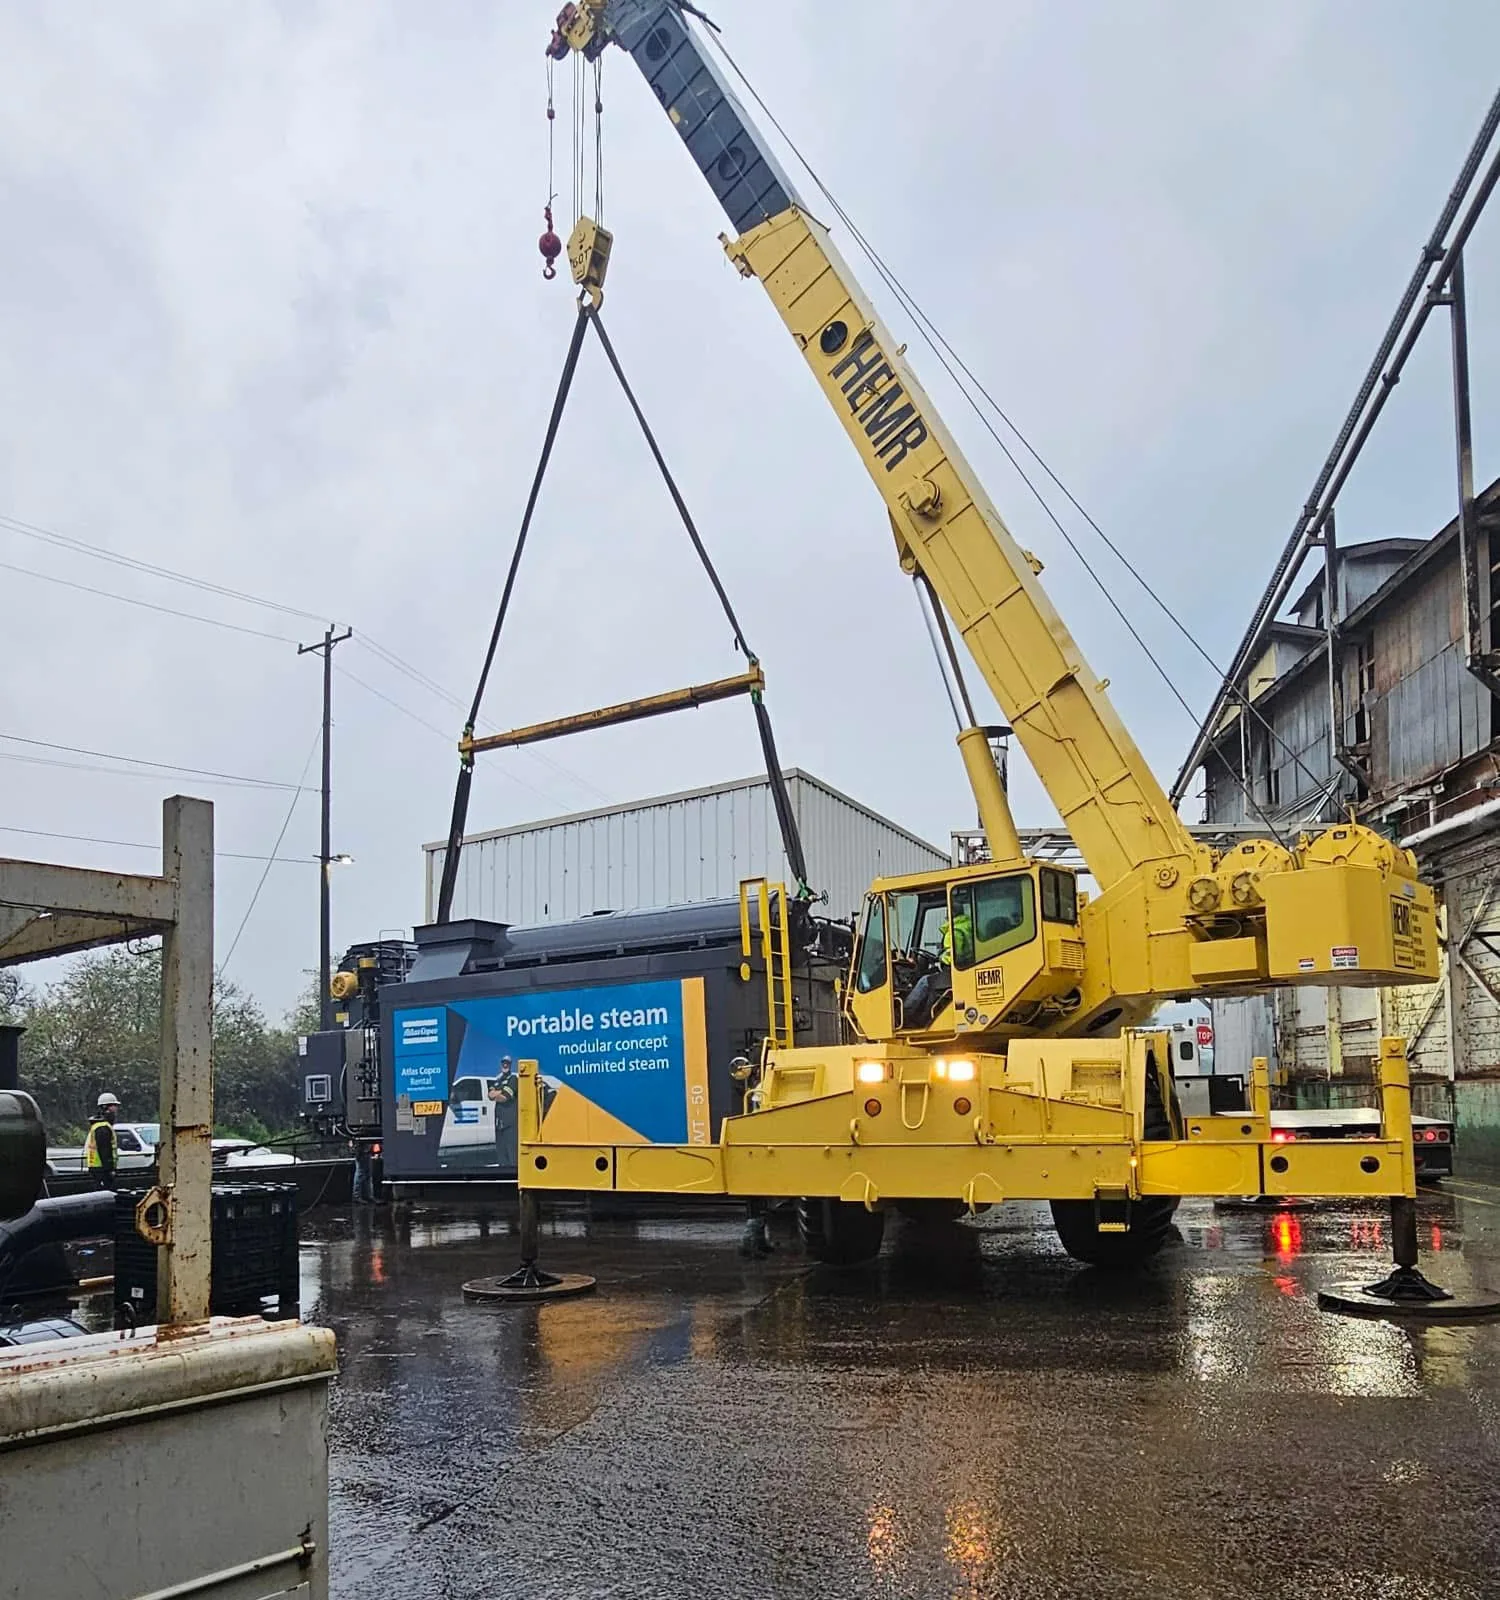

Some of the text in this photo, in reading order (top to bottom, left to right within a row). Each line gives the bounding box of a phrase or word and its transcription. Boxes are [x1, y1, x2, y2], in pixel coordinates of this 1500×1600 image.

[829, 330, 928, 472] HEMR
[977, 969, 1001, 986] HEMR
[507, 1007, 668, 1037] Portable steam
[1198, 1031, 1212, 1040] TOP
[558, 1035, 669, 1055] modular concept
[401, 1066, 441, 1077] Atlas Copco
[565, 1057, 670, 1075] unlimited steam
[409, 1076, 432, 1085] Rental
[692, 1085, 705, 1105] 50
